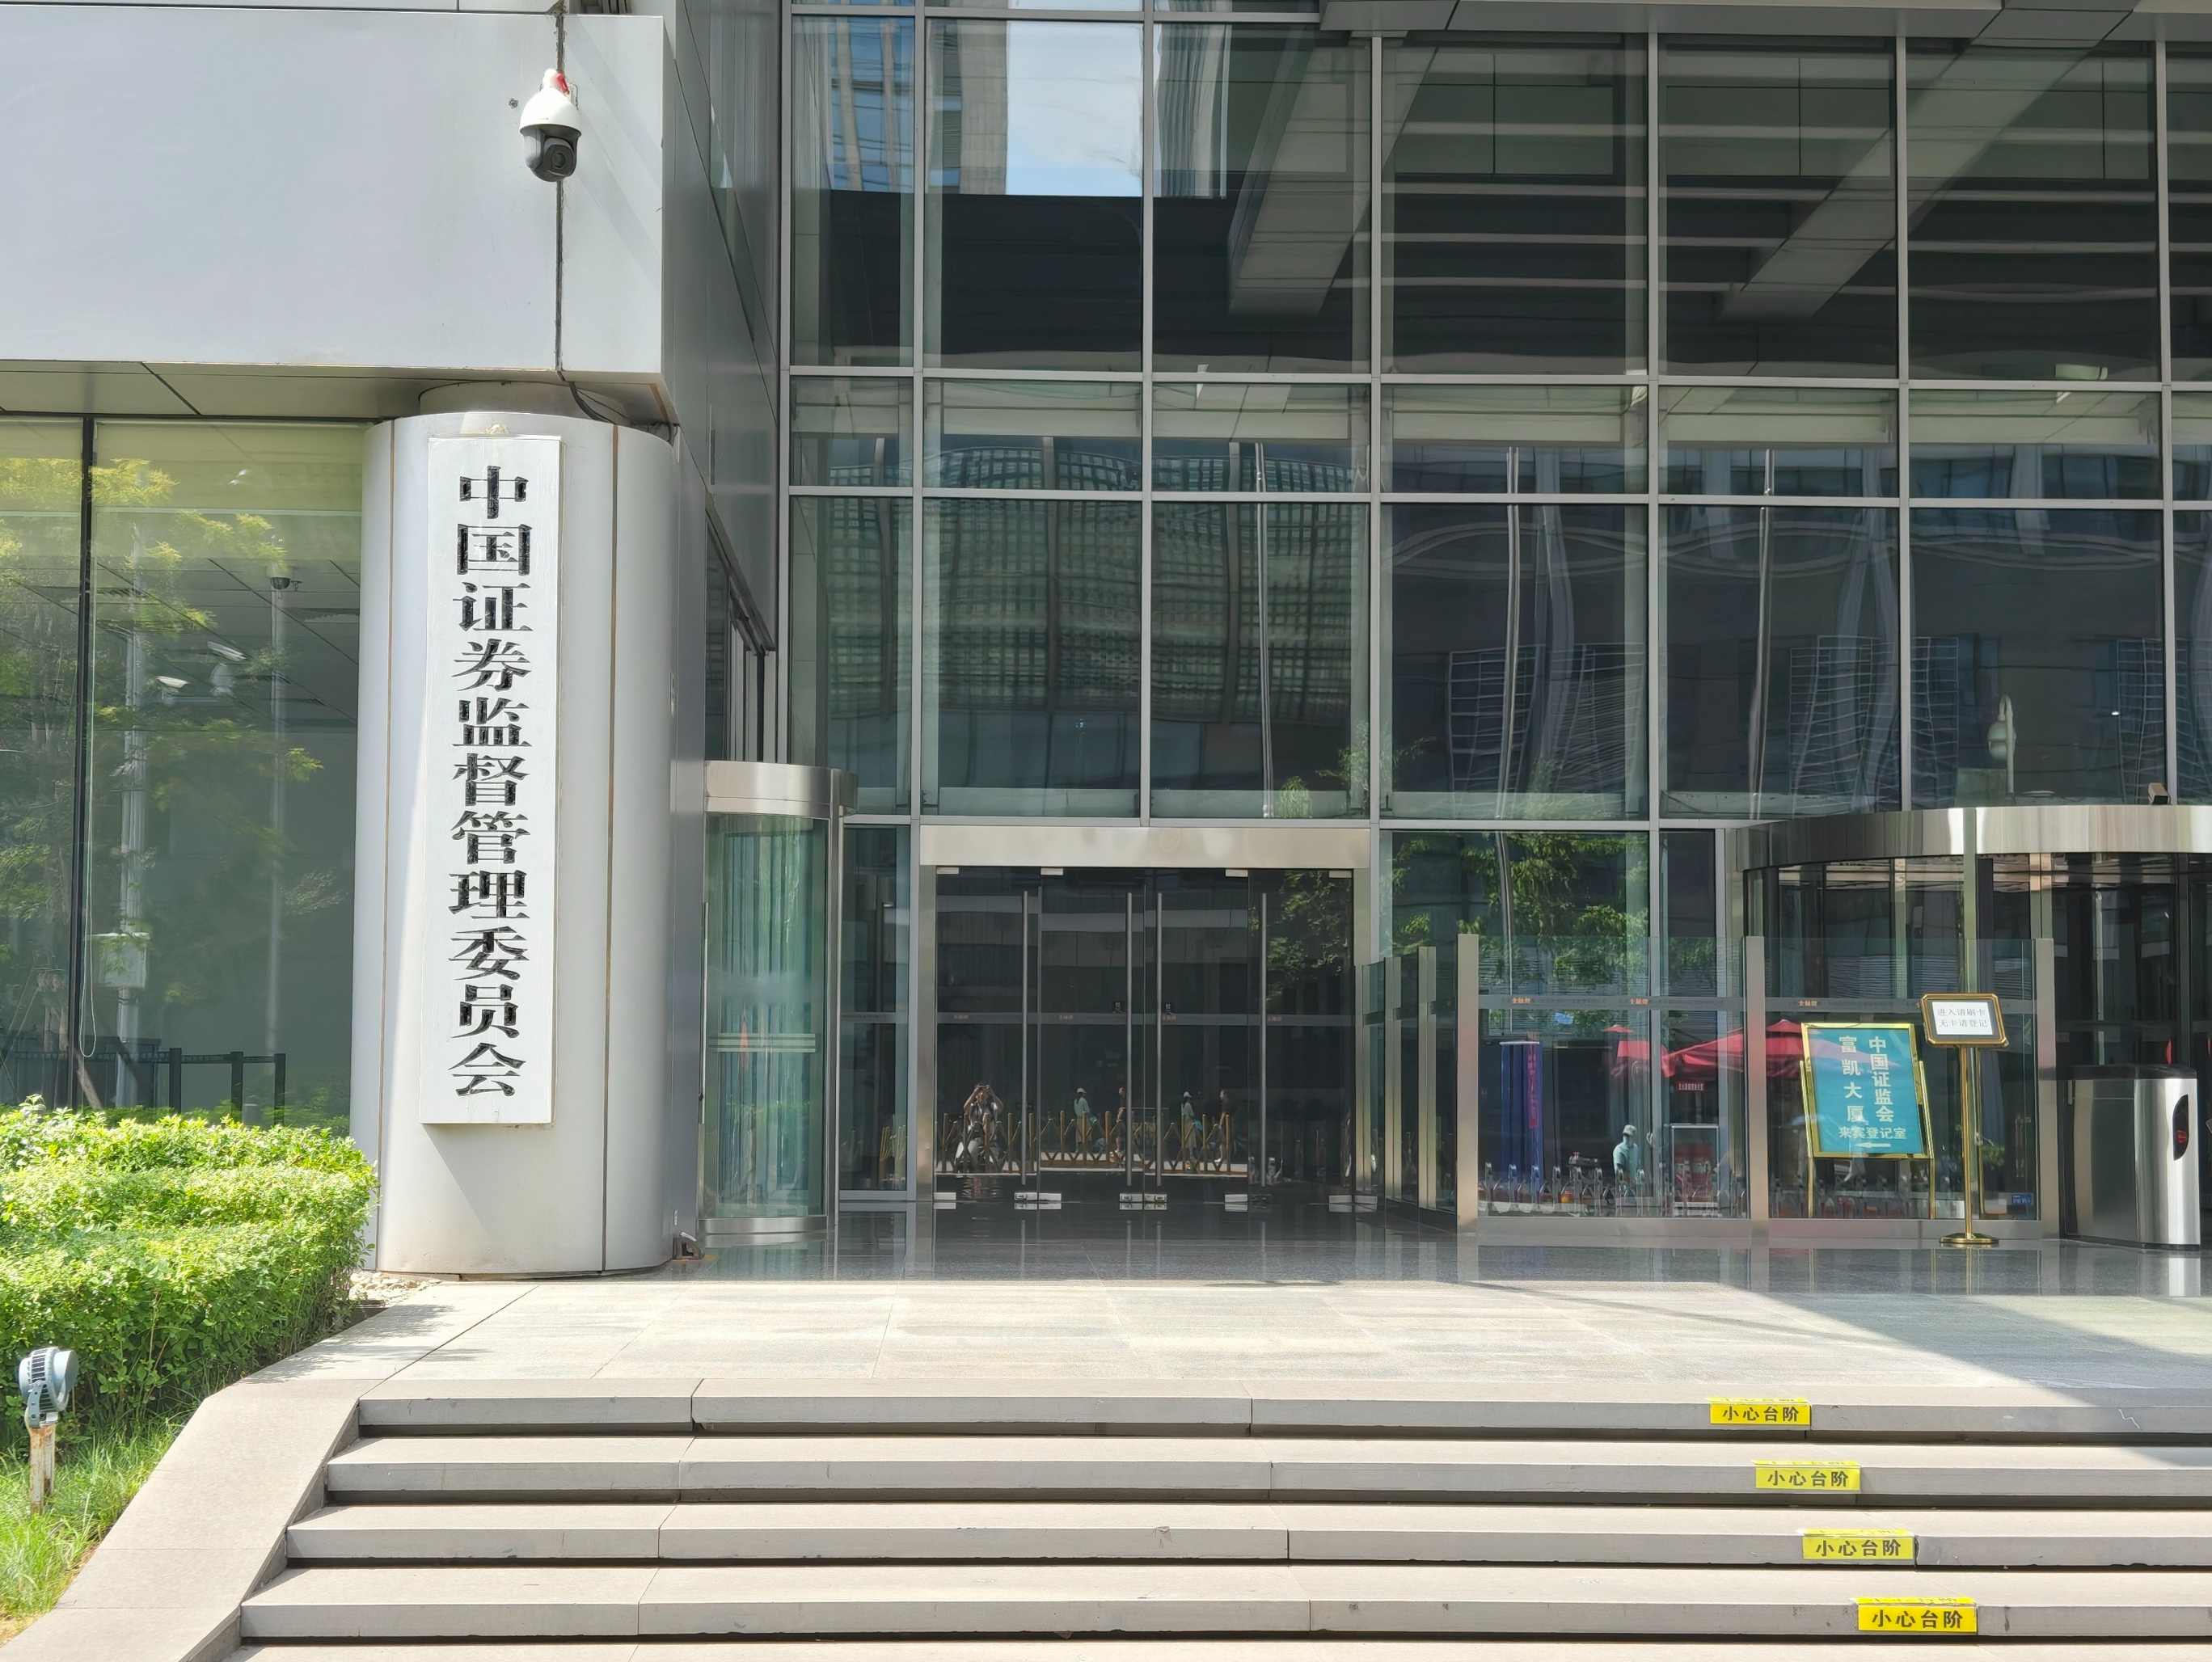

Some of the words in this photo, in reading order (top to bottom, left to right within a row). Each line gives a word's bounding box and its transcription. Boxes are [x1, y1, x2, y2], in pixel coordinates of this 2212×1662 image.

[448, 466, 534, 1098] 中国证券监督管理委员会
[1937, 1008, 1986, 1017] 进入请刷卡
[1940, 1019, 1988, 1027] 无卡请登记
[1838, 1036, 1865, 1123] 富凯大厦
[1868, 1036, 1894, 1123] 中国证监会
[1838, 1126, 1907, 1140] 来宾登记室
[1722, 1406, 1800, 1422] 小心台阶
[1767, 1470, 1849, 1487] 小心台阶
[1815, 1539, 1902, 1557] 小心台阶
[1871, 1609, 1964, 1629] 小心台阶
